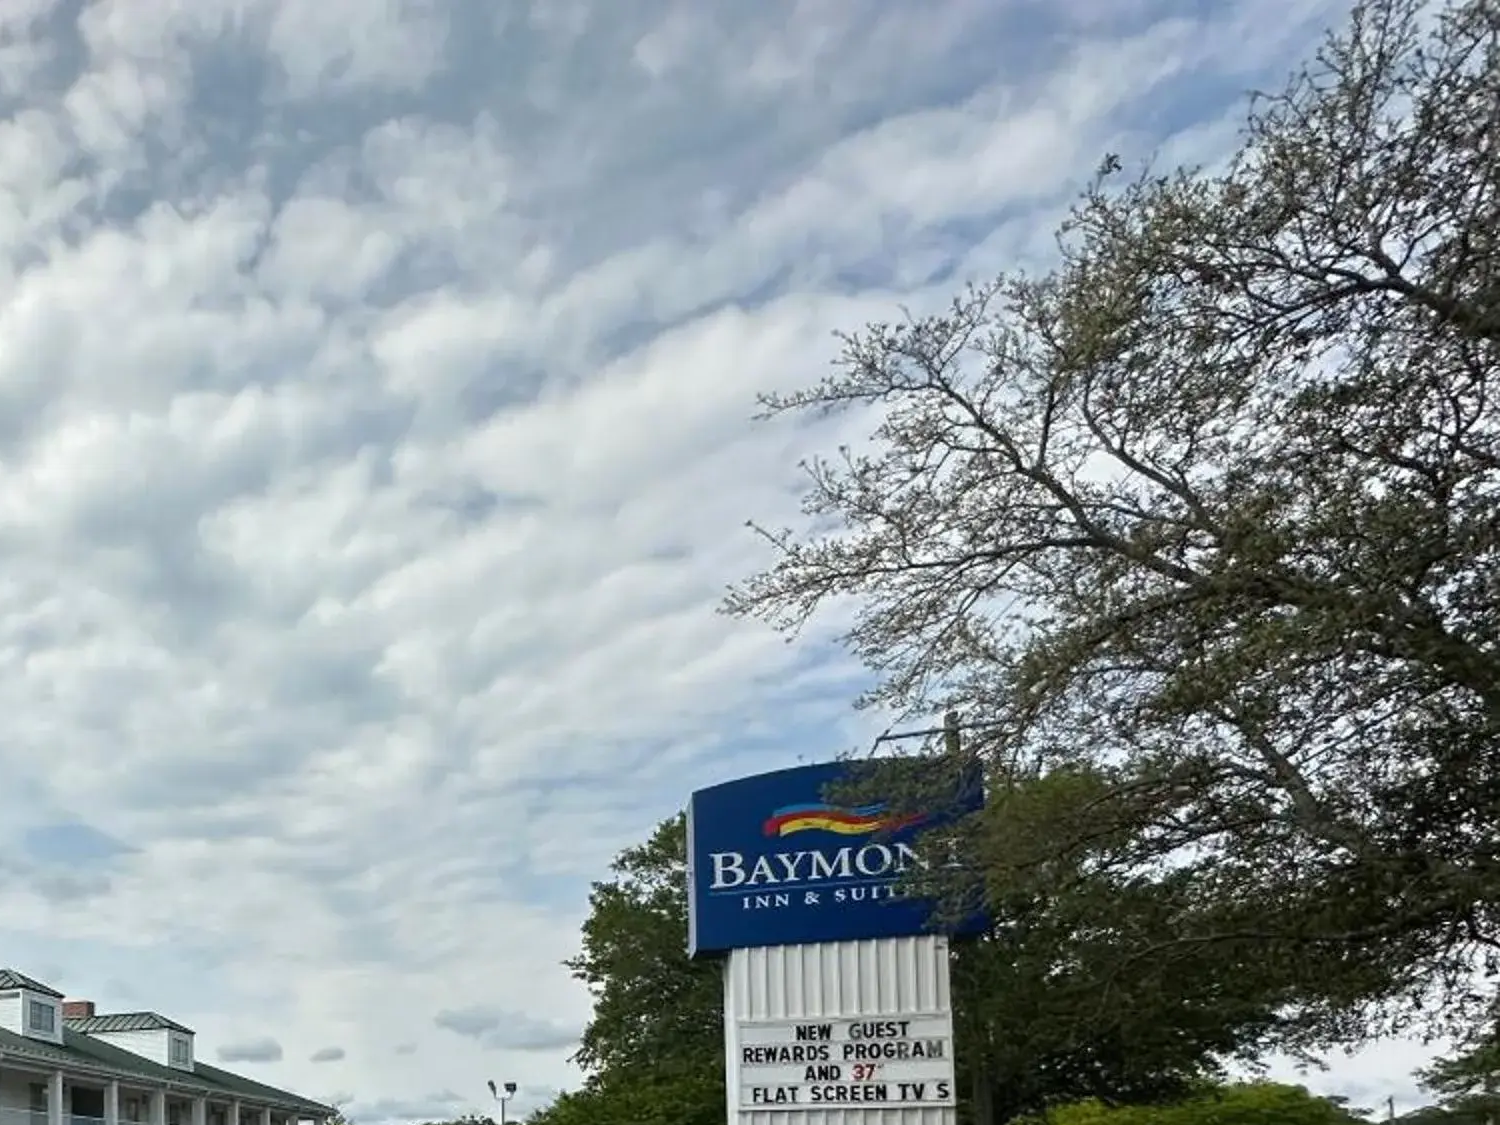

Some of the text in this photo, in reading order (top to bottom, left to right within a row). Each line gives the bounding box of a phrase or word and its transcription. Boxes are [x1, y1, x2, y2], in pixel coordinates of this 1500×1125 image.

[743, 893, 790, 910] INN
[804, 891, 821, 905] &
[796, 1021, 910, 1041] NEW GUEST
[743, 1041, 943, 1063] REWARDS PROGRAM
[804, 1065, 841, 1081] AND
[752, 1086, 799, 1103] FLAT
[810, 1084, 887, 1101] SCREEN
